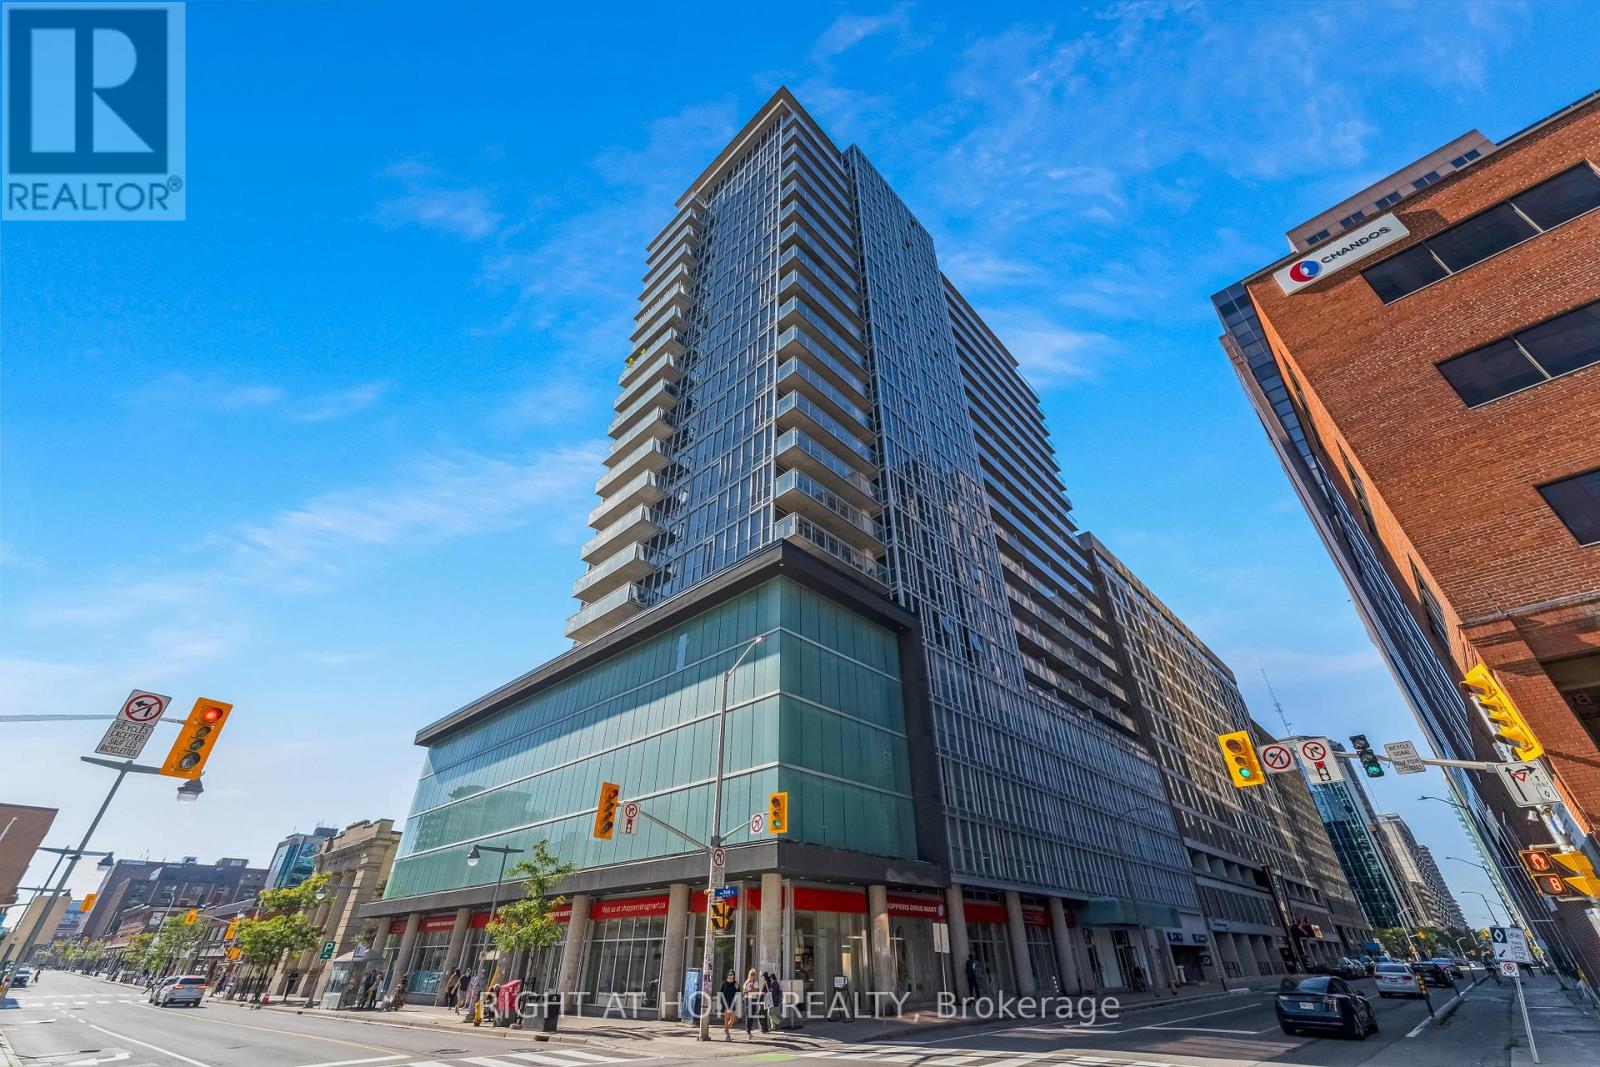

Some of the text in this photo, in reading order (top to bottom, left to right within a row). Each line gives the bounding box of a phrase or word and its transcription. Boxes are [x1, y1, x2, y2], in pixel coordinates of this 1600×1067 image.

[1321, 226, 1391, 264] CHANDOS
[114, 722, 150, 734] BICYCLES
[110, 730, 145, 741] EXCEPTED
[125, 740, 138, 749] LES
[1550, 877, 1562, 891] 8
[887, 903, 910, 911] OPPERS
[323, 942, 334, 953] P
